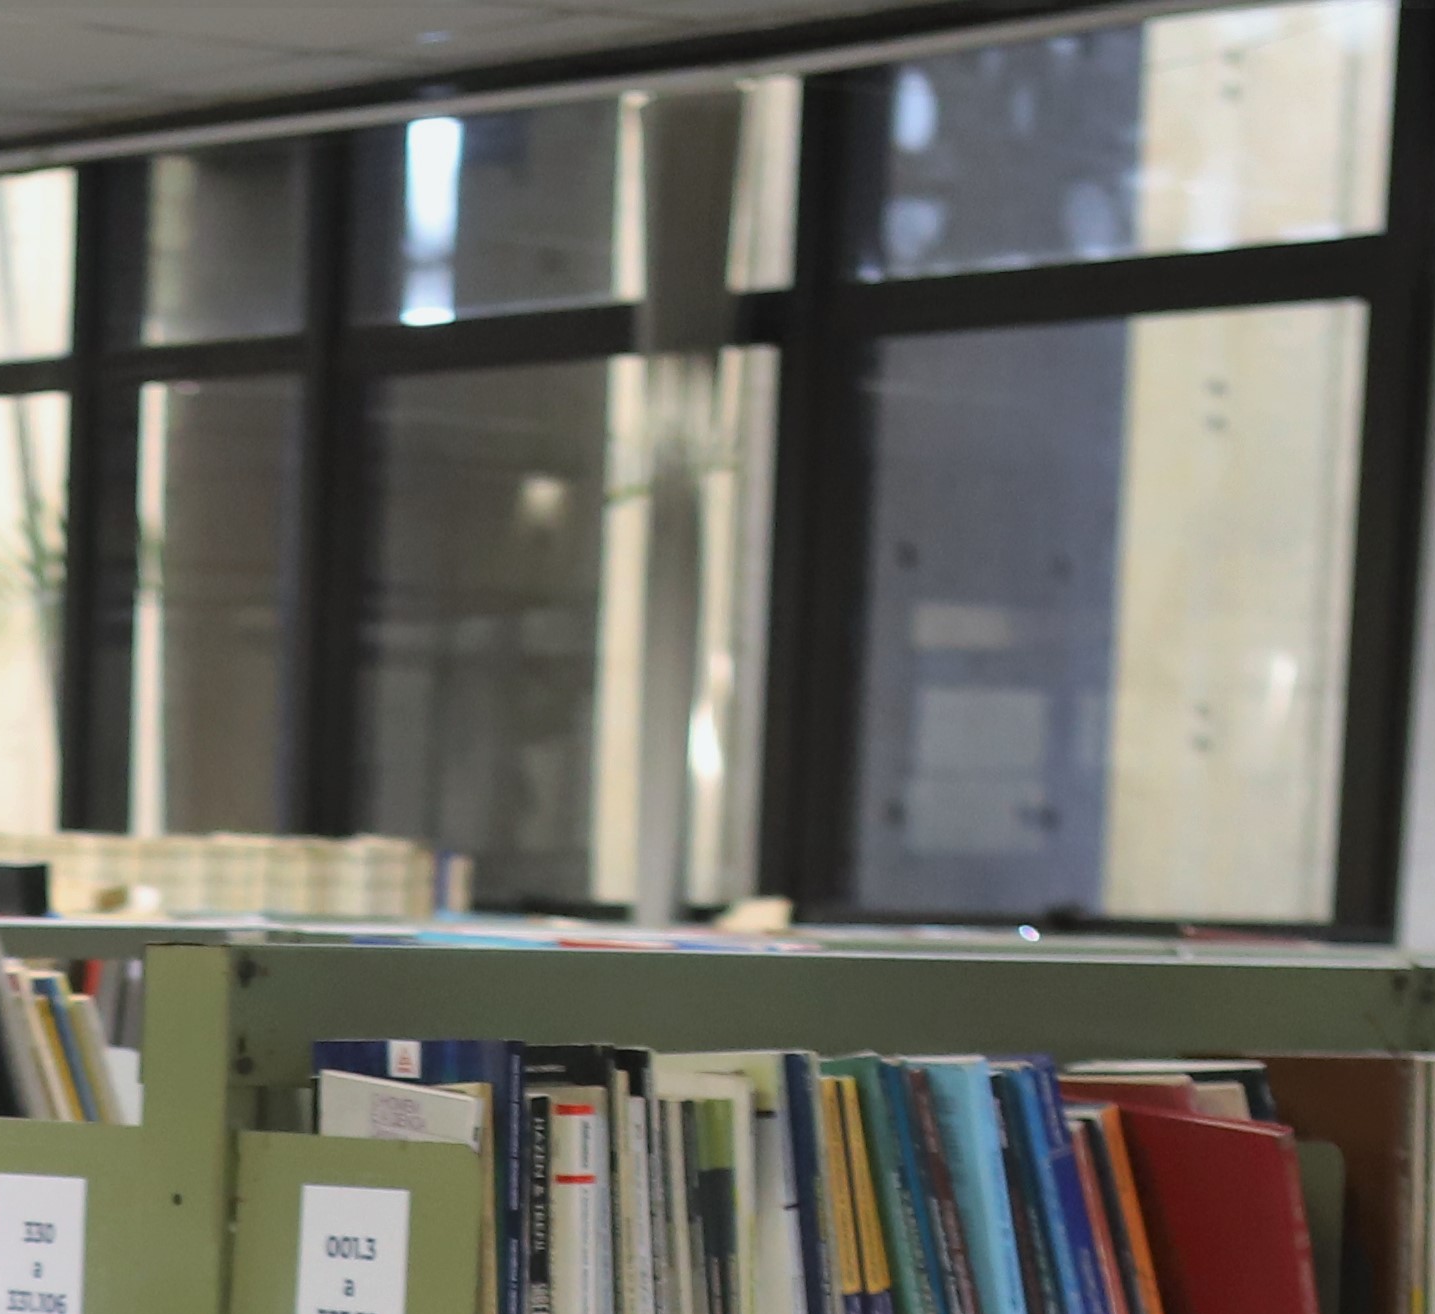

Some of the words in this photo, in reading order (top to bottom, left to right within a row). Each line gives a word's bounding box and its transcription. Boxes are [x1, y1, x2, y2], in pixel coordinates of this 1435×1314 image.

[327, 1235, 376, 1261] 001.3
[32, 1261, 42, 1279] a
[344, 1279, 354, 1297] a
